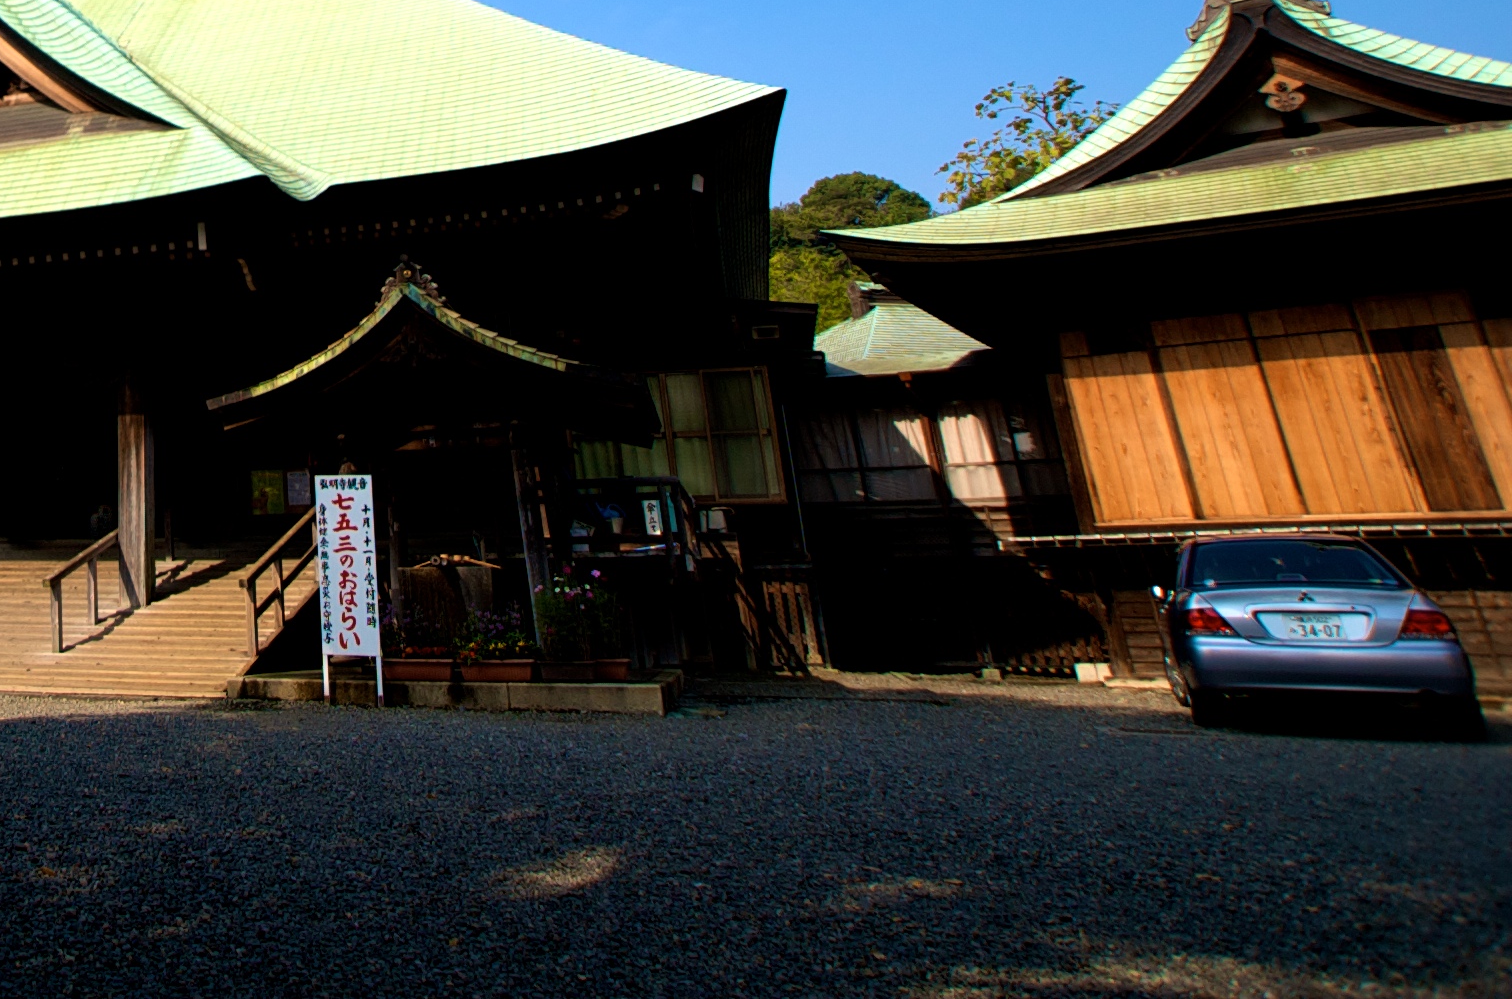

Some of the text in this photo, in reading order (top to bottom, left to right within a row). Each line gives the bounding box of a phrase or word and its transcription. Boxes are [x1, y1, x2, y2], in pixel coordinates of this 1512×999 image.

[331, 493, 361, 649] 七五三のおはらい
